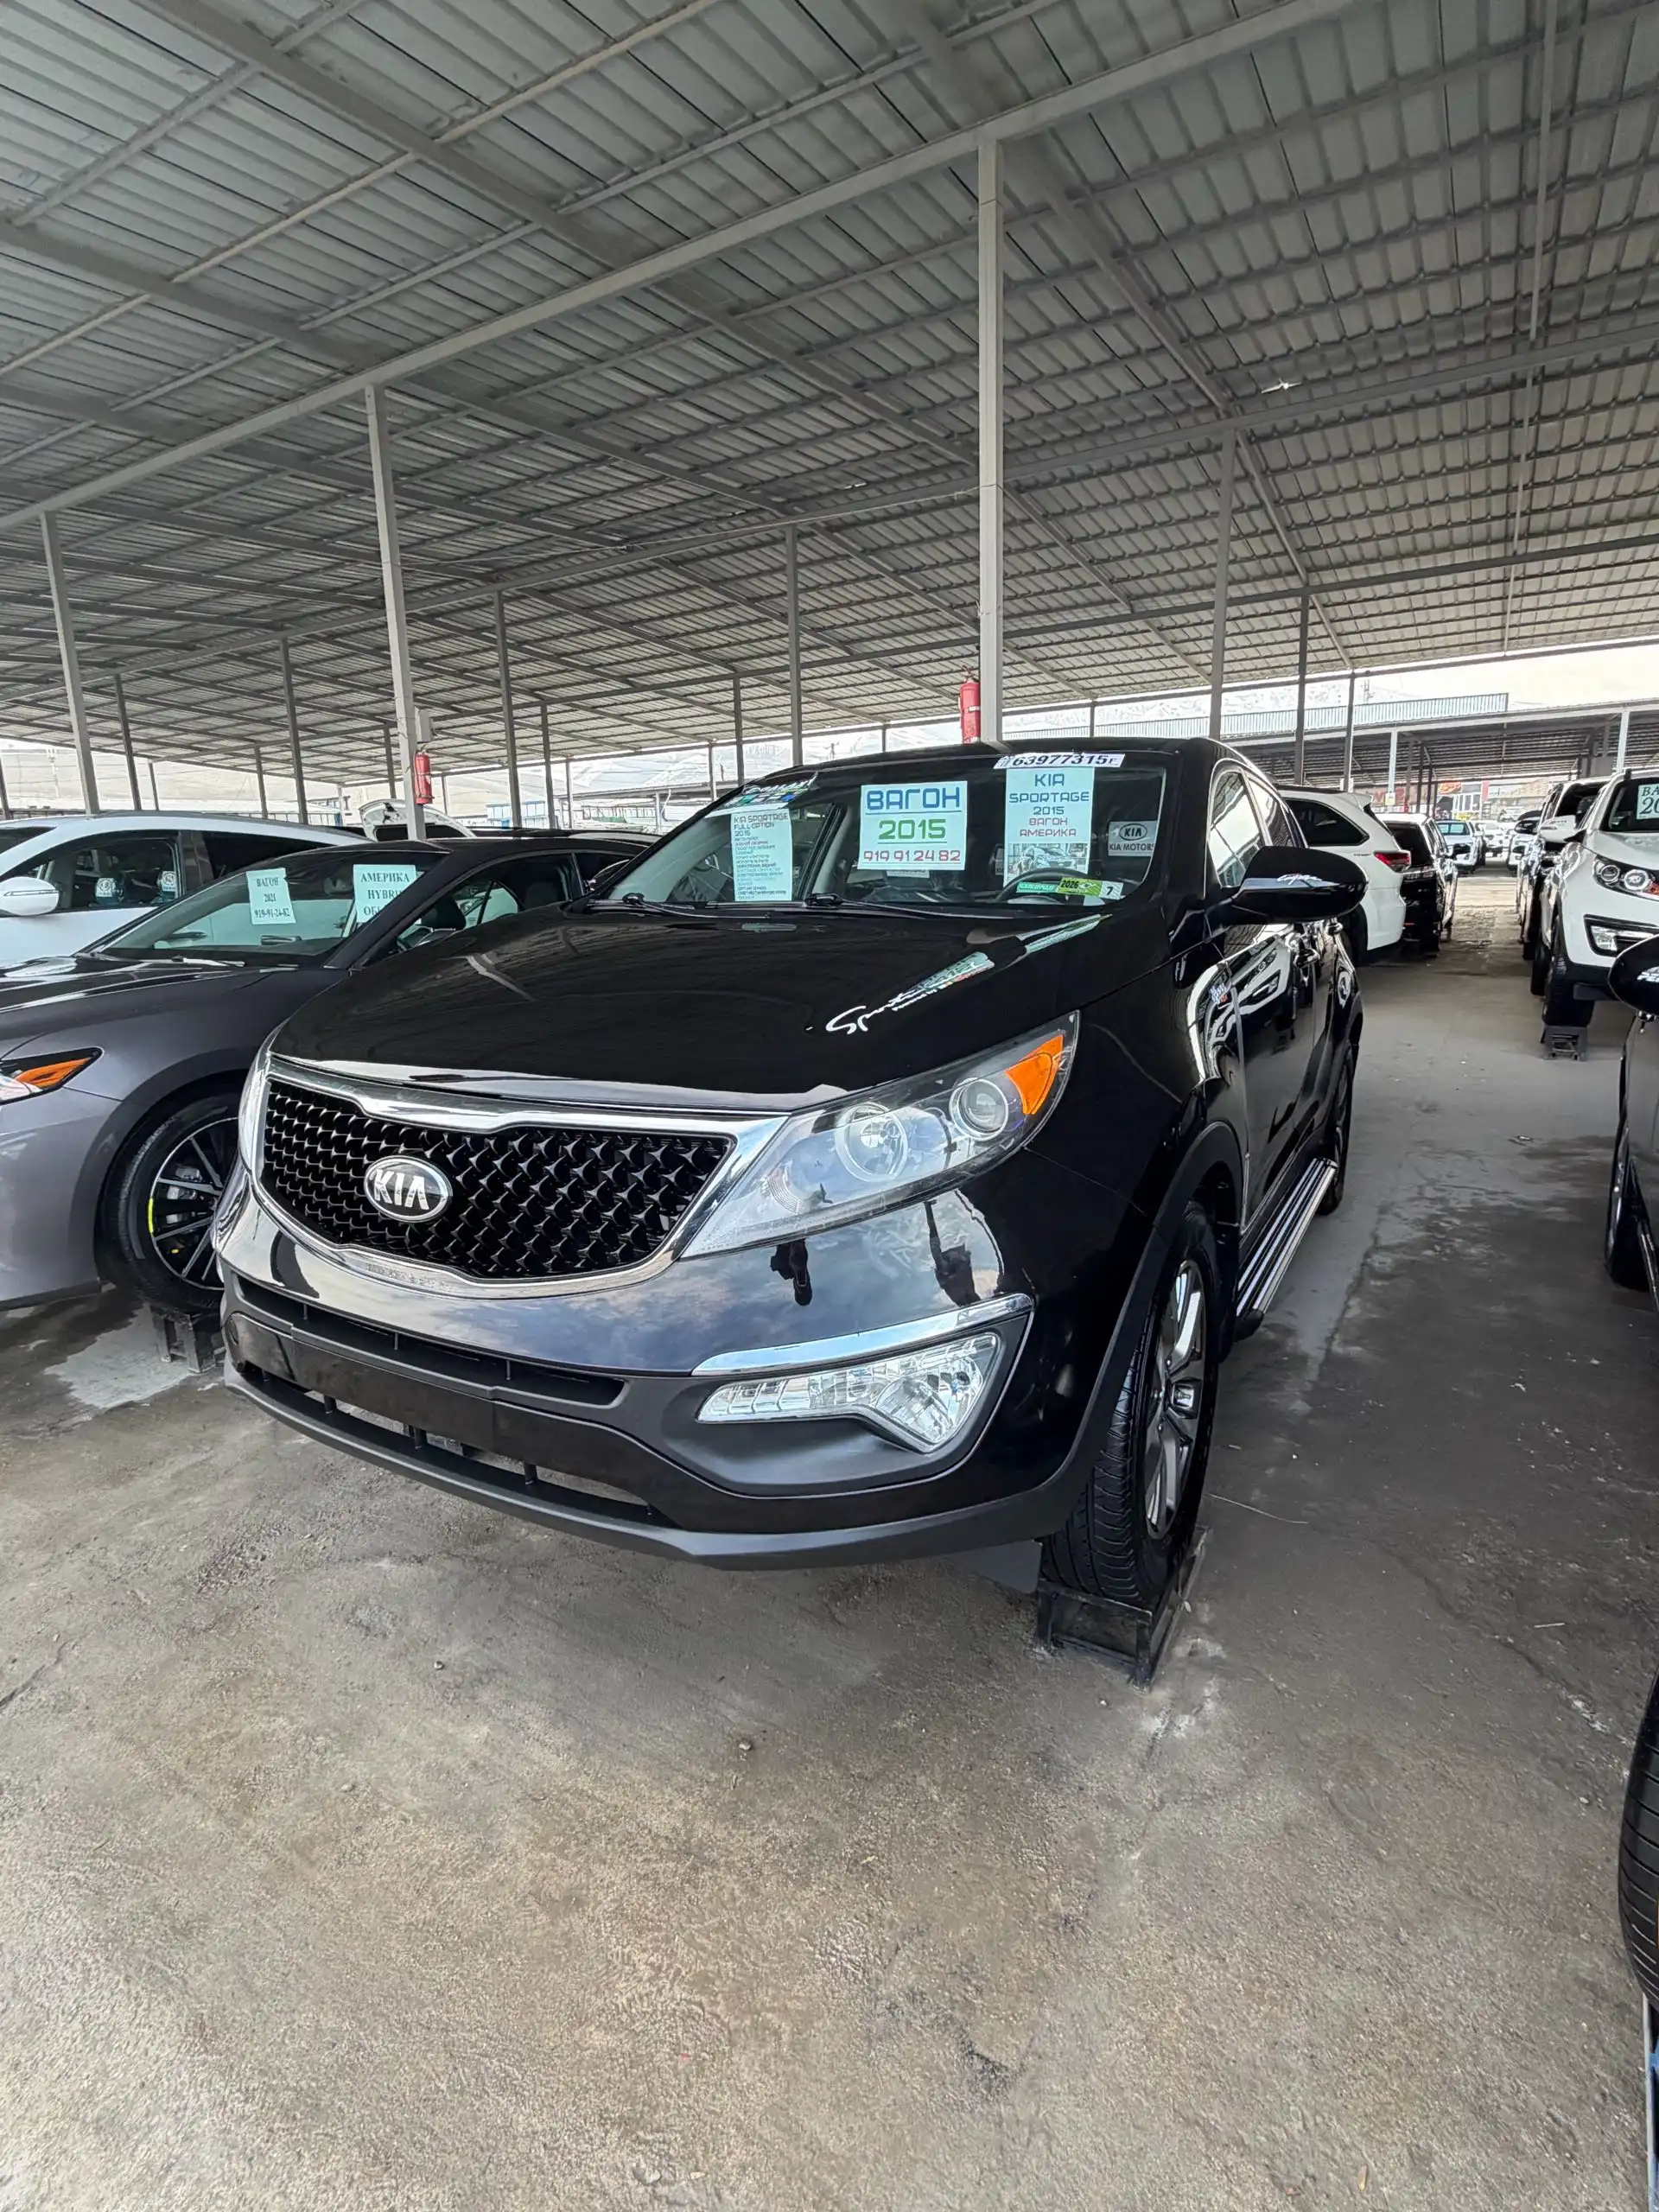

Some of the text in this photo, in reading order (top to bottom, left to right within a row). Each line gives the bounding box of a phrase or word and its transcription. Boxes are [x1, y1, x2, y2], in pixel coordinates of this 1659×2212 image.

[1034, 773, 1065, 786] KIA
[867, 786, 960, 810] ВАГОН
[1008, 791, 1090, 803] SPORTAGE
[1033, 806, 1065, 816] 2015
[747, 812, 789, 823] SPORTAGE
[1029, 817, 1068, 826] ВАГОН
[879, 818, 946, 840] 2015
[1020, 829, 1077, 837] АМЕРИКА
[1124, 827, 1142, 837] KIA
[1109, 842, 1122, 851] KIA
[863, 849, 961, 861] 919 91 24 82
[256, 877, 279, 887] ВАГОН
[360, 872, 410, 882] АМЕРИКА
[1060, 880, 1079, 889] 2026
[367, 889, 401, 899] HYBRI
[1106, 887, 1113, 895] 7
[373, 1168, 430, 1211] KIA
